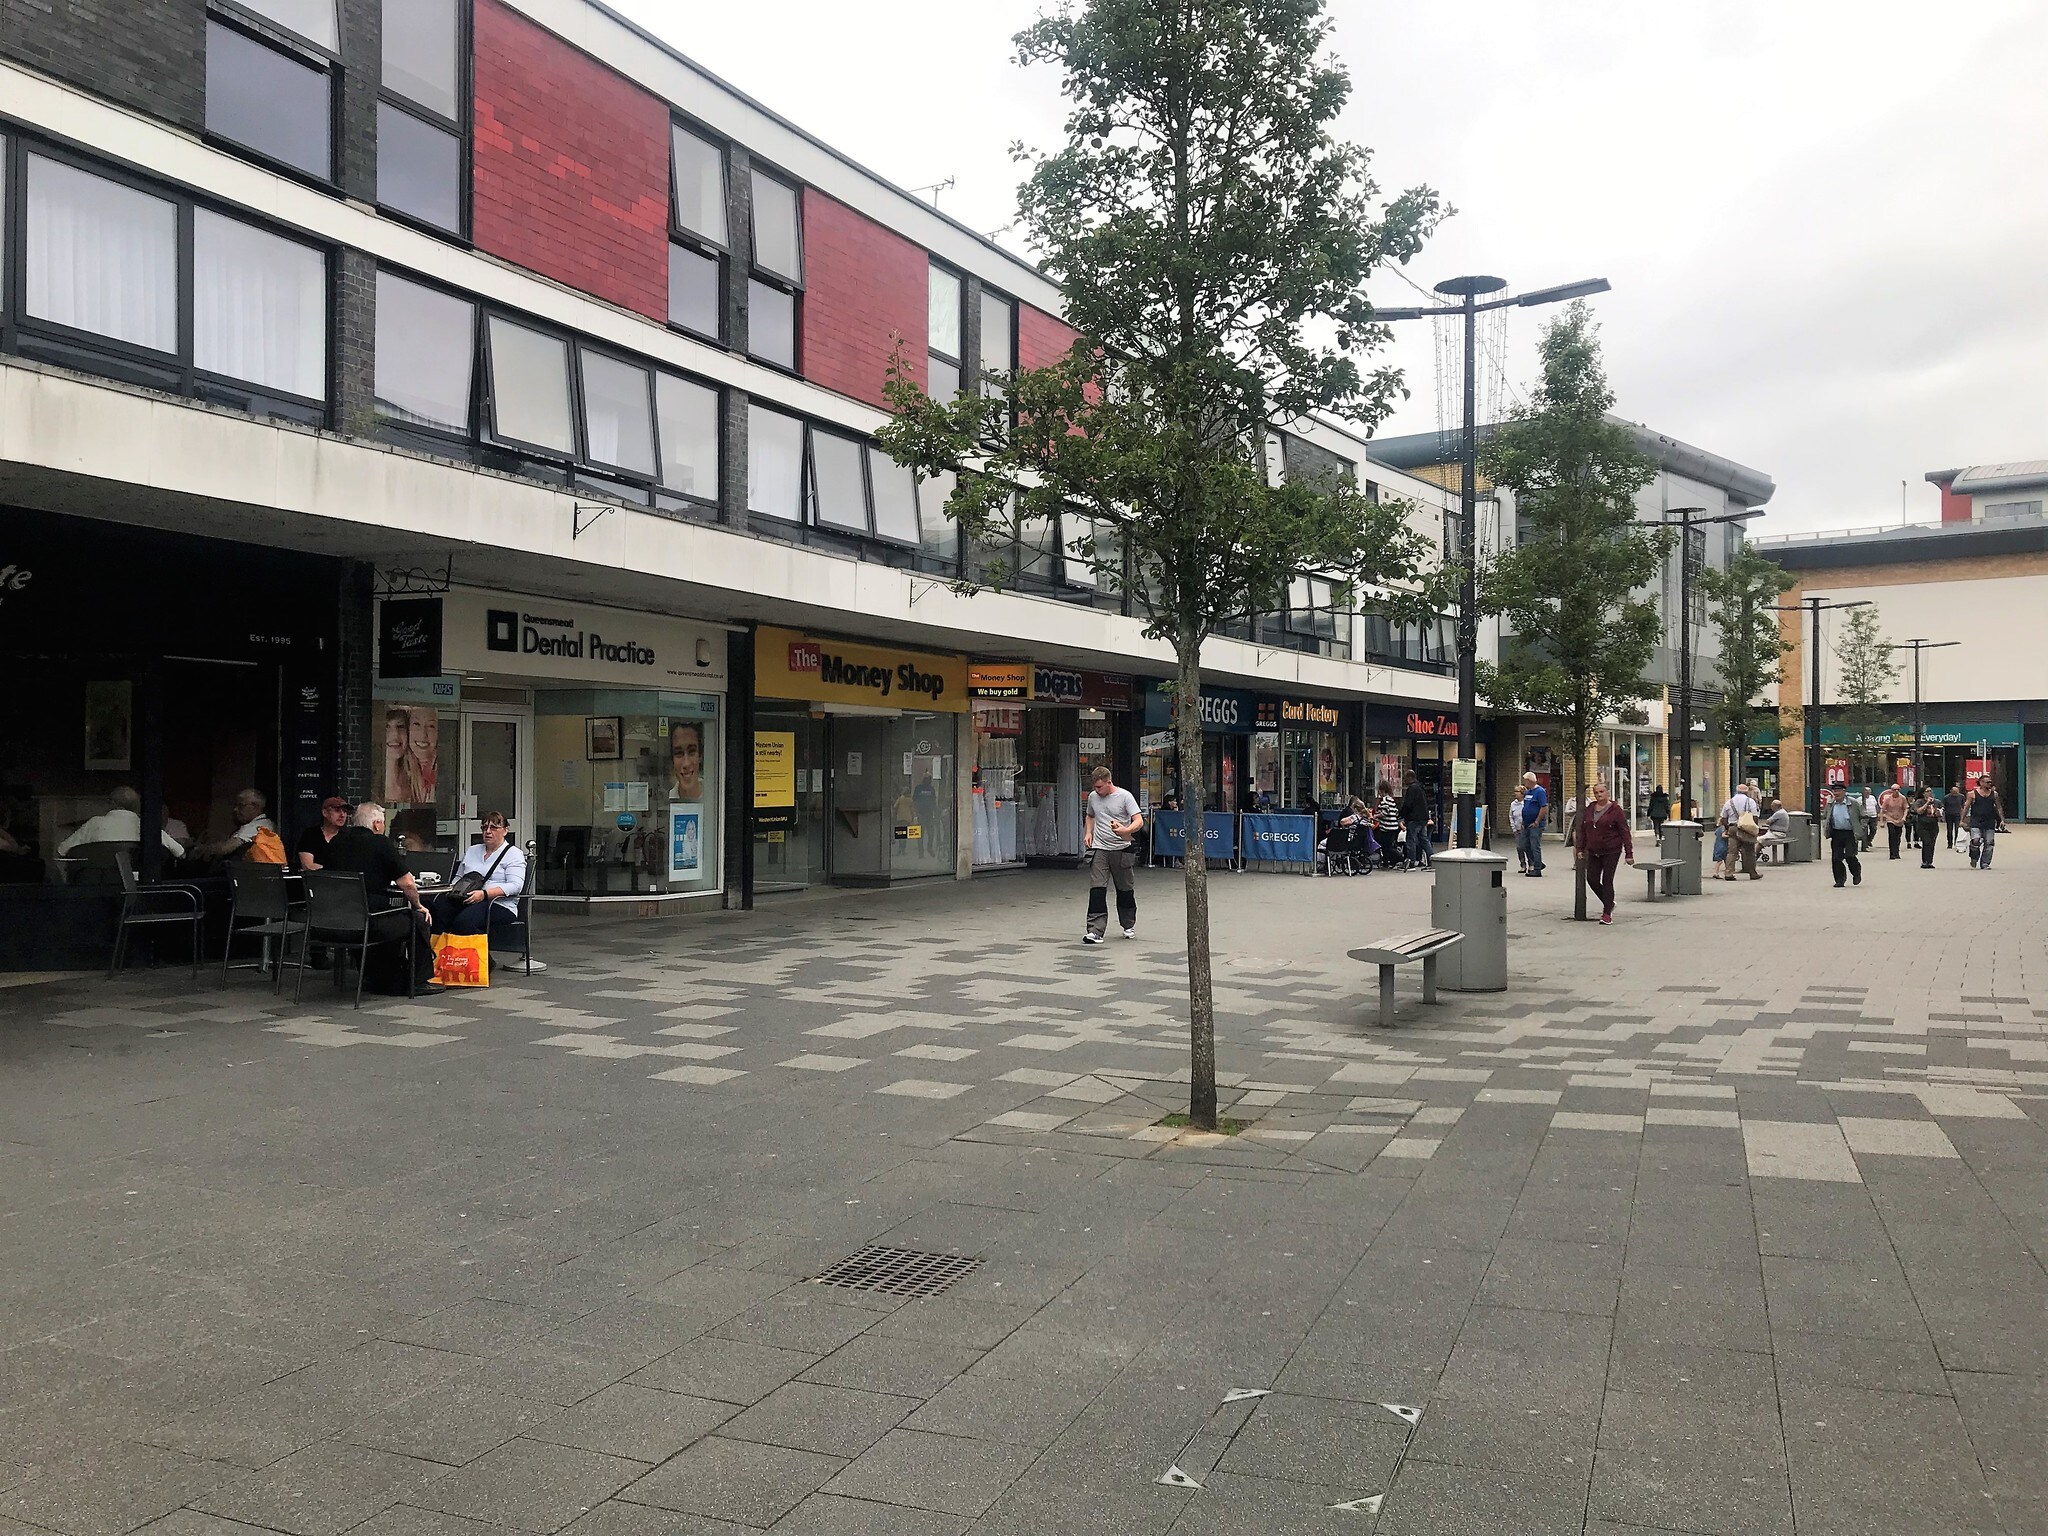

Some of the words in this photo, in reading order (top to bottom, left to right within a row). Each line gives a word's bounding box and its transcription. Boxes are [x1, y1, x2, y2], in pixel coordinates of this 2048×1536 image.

[523, 613, 575, 628] Queensmead
[523, 627, 584, 658] Dental
[590, 633, 656, 665] Practice
[794, 648, 818, 667] The
[821, 653, 893, 696] Money
[898, 663, 944, 700] Shop
[980, 674, 1005, 683] Money
[1007, 673, 1025, 683] Shop
[433, 684, 453, 694] NHS
[989, 688, 1002, 697] buy
[1003, 687, 1018, 696] gold
[975, 709, 1020, 728] SALE
[1282, 700, 1304, 720] Card
[1306, 703, 1339, 727] Factory
[1255, 720, 1277, 728] GREGGS
[1406, 713, 1435, 735] Shoe
[1437, 715, 1459, 736] Zon
[1920, 732, 1961, 743] Everyday!
[1261, 832, 1300, 842] GREGGS
